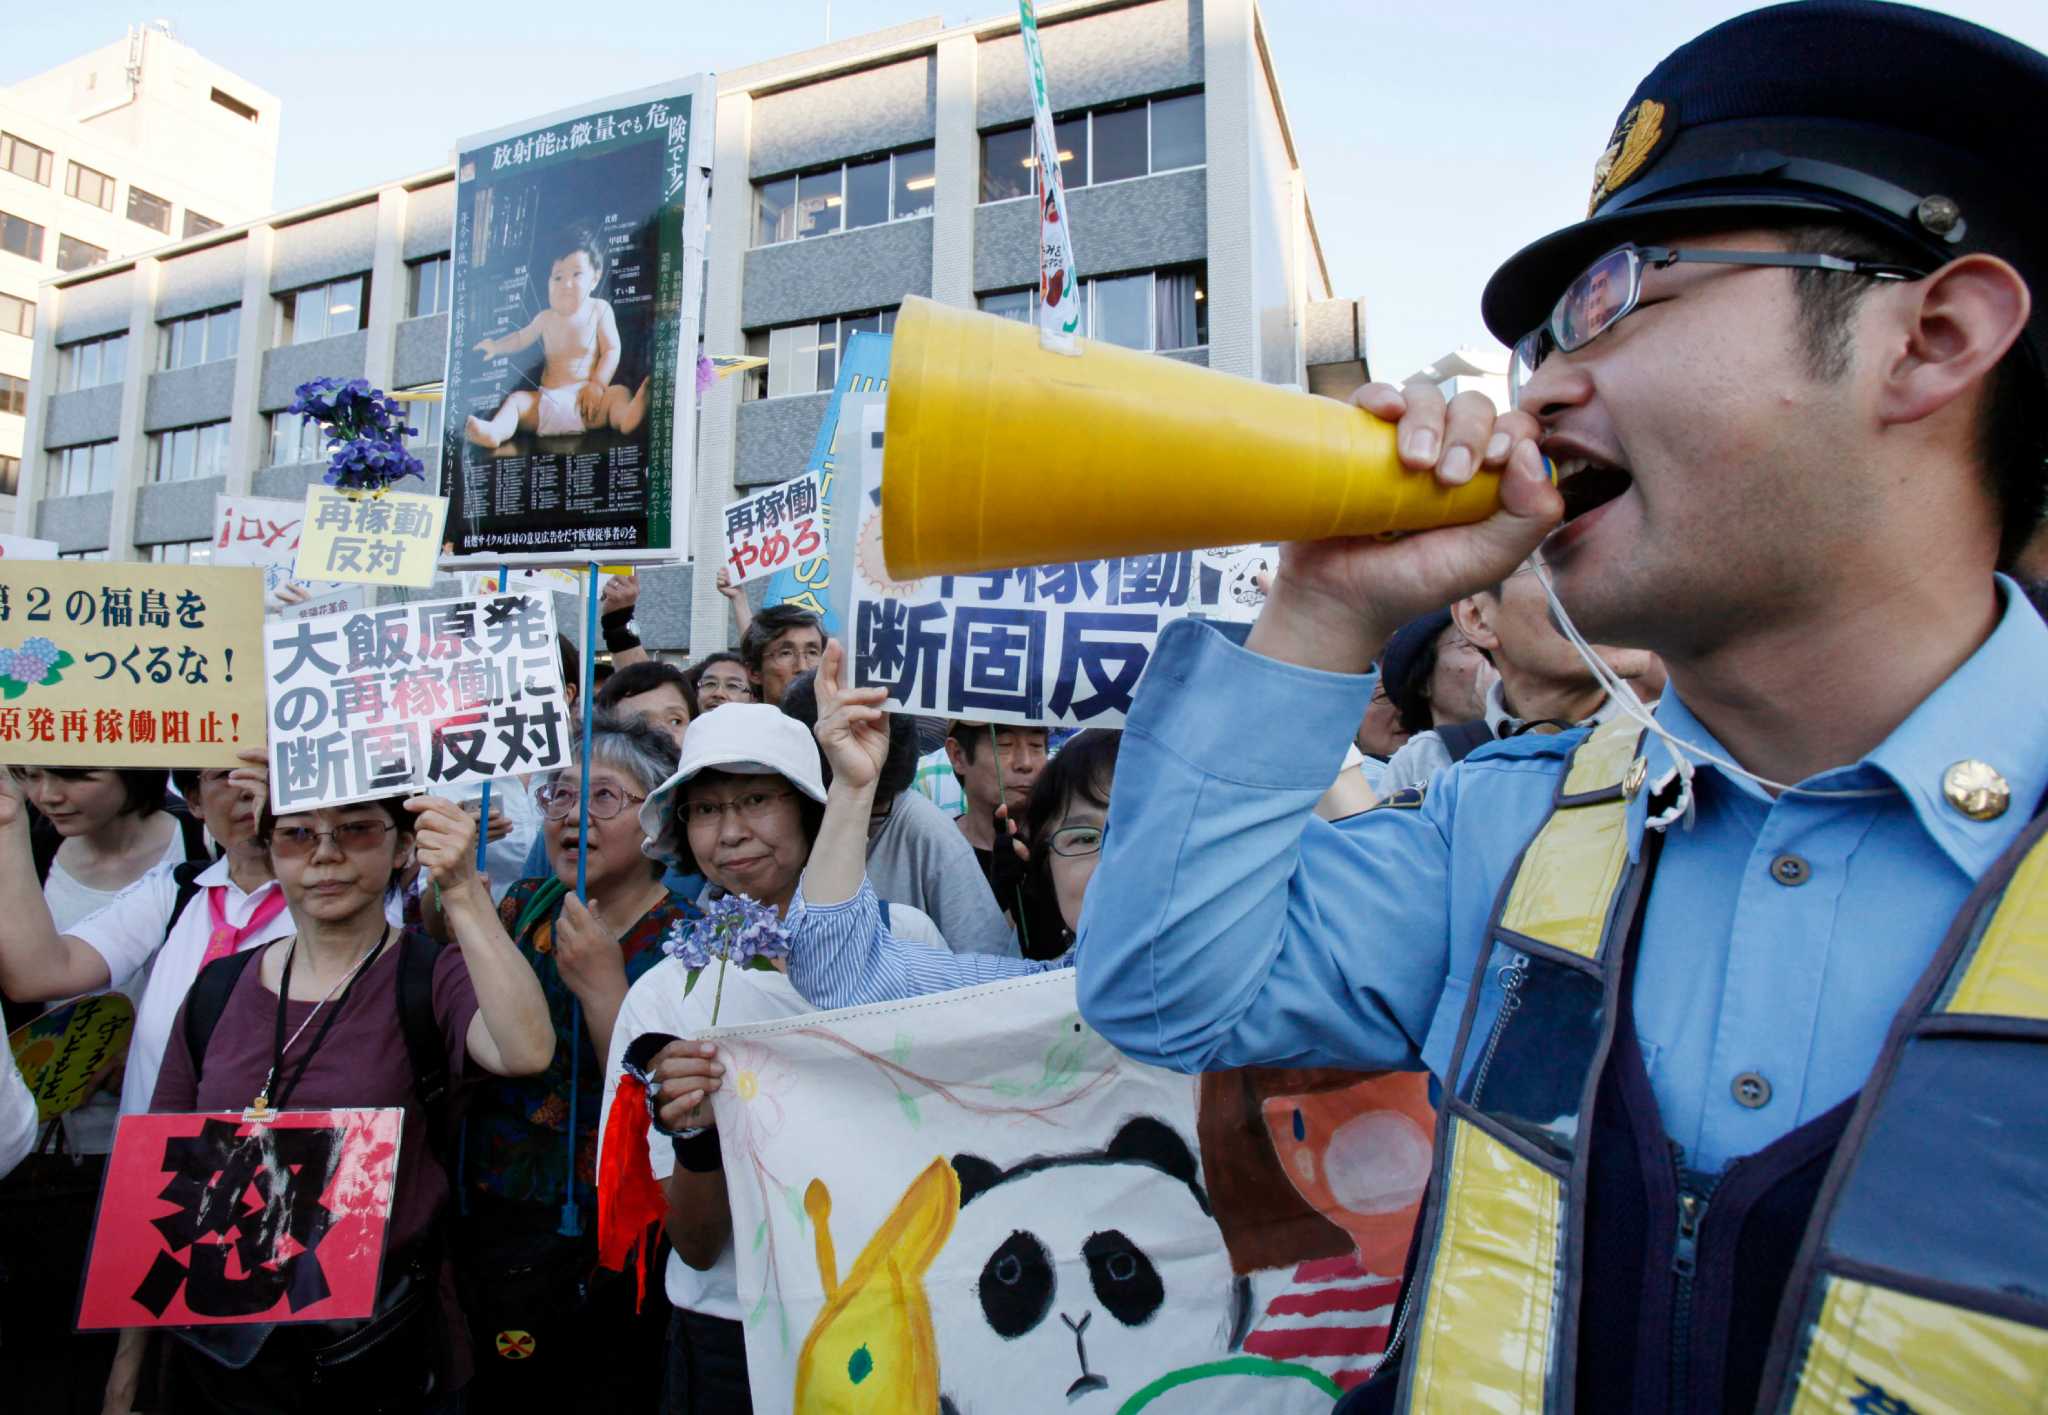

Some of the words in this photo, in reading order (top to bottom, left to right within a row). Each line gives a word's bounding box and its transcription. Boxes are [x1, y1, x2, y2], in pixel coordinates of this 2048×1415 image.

[315, 495, 433, 538] 再稼動
[726, 476, 817, 544] 再稼働
[326, 536, 406, 576] 反対
[728, 518, 821, 579] やめろ
[84, 644, 234, 684] つくるな!
[273, 595, 549, 684] 大飯原発
[855, 598, 1206, 721] 断固反
[0, 707, 240, 744] 原発再稼働阻止!
[273, 654, 556, 733] の再稼働に
[275, 700, 562, 807] 断固反対
